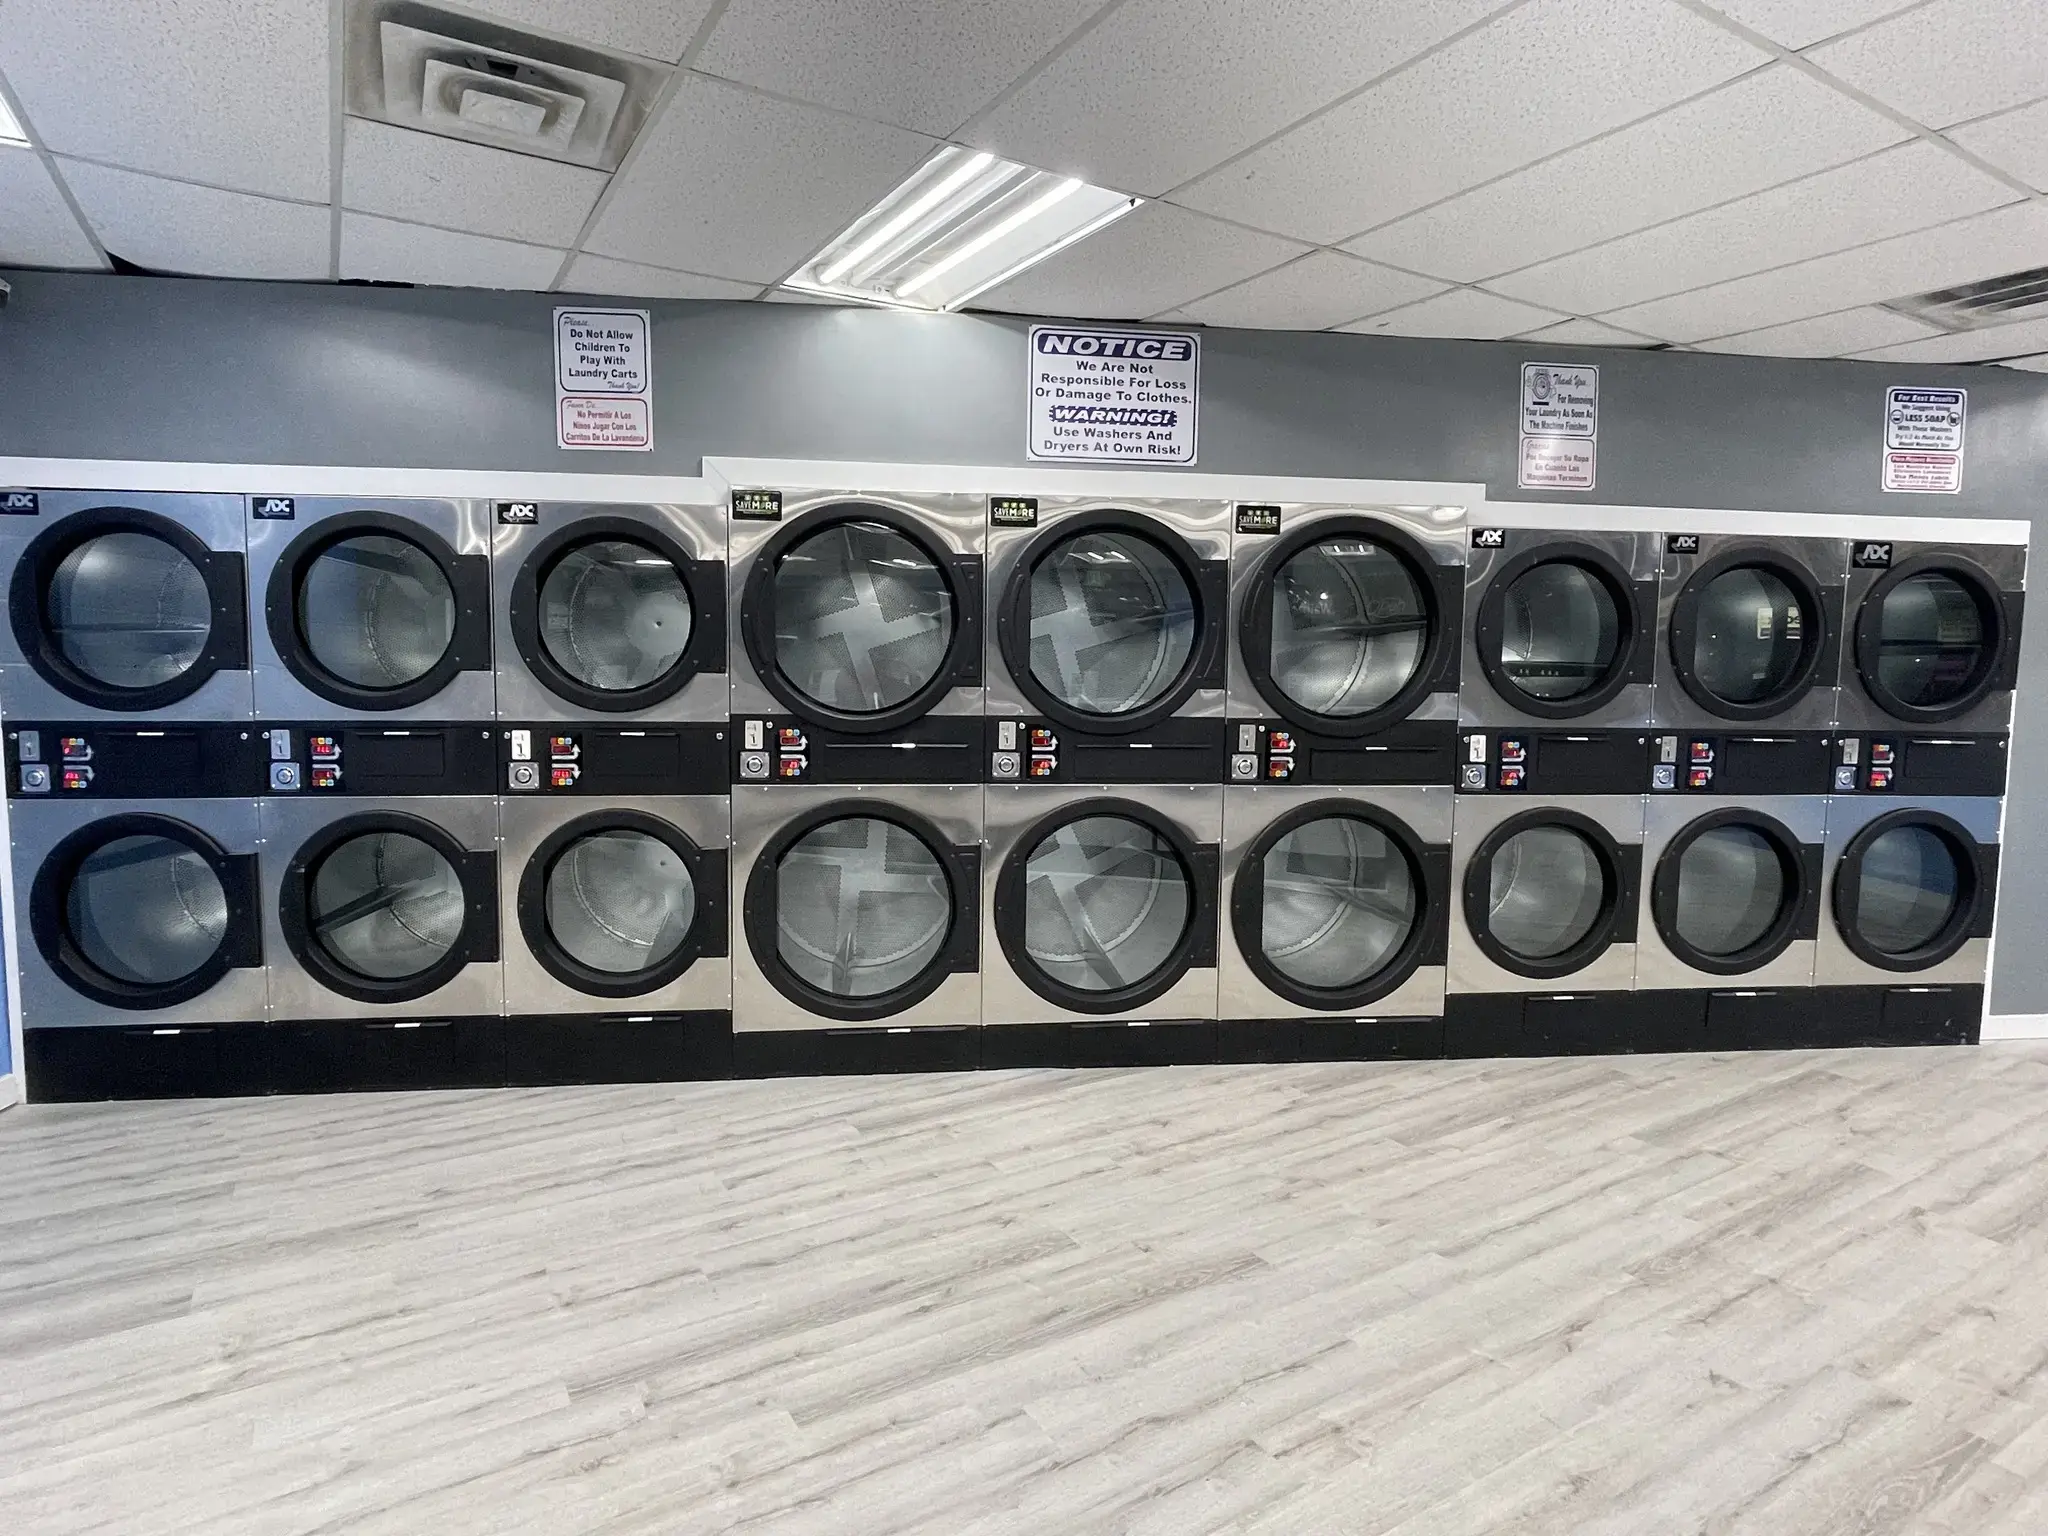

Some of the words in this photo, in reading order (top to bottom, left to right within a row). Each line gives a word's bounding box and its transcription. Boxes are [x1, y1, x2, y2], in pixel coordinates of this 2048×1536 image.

[570, 328, 583, 338] Do
[586, 330, 603, 339] Not
[606, 330, 633, 340] Allow
[575, 342, 615, 352] Children
[618, 344, 630, 352] To
[1042, 335, 1187, 359] NOTICE
[580, 355, 600, 366] Play
[604, 356, 626, 365] With
[1076, 360, 1097, 371] We
[1101, 362, 1125, 373] Are
[1130, 364, 1153, 374] Not
[568, 368, 608, 380] Laundry
[611, 369, 638, 378] Carts
[1553, 374, 1573, 386] Thank
[607, 381, 625, 389] Thank
[1041, 374, 1125, 387] Responsible
[1130, 378, 1151, 388] For
[1155, 378, 1187, 390] Loss
[1035, 388, 1051, 397] Or
[1056, 388, 1111, 402] Damage
[1116, 390, 1132, 401] To
[1136, 392, 1192, 404] Clothes.
[1558, 394, 1567, 404] For
[1568, 394, 1593, 407] Removing
[1912, 394, 1929, 402] Best
[577, 410, 586, 418] No
[588, 410, 613, 419] Permitir
[614, 411, 619, 419] A
[1053, 409, 1170, 424] WARNING!
[1526, 407, 1538, 416] Your
[1539, 408, 1561, 419] Laundry
[1562, 408, 1570, 418] As
[1571, 409, 1585, 419] Soon
[1586, 410, 1593, 419] As
[1905, 414, 1923, 422] LESS
[1924, 414, 1946, 423] SOAP
[592, 422, 610, 432] Jugar
[612, 422, 624, 430] Con
[1529, 420, 1540, 430] The
[1542, 420, 1564, 430] Machine
[566, 432, 591, 441] Carritos
[592, 433, 600, 441] De
[1053, 427, 1080, 437] Use
[1084, 428, 1142, 440] Washers
[1146, 430, 1172, 441] And
[1044, 440, 1089, 453] Dryers
[1094, 442, 1109, 452] At
[1113, 443, 1143, 454] Own
[1148, 444, 1181, 455] Risk!
[1564, 454, 1572, 462] Su
[1574, 455, 1589, 463] Ropa
[265, 499, 290, 512] ADC
[509, 504, 534, 517] ADC
[1677, 536, 1696, 548] ADC
[1863, 544, 1890, 560] ADC
